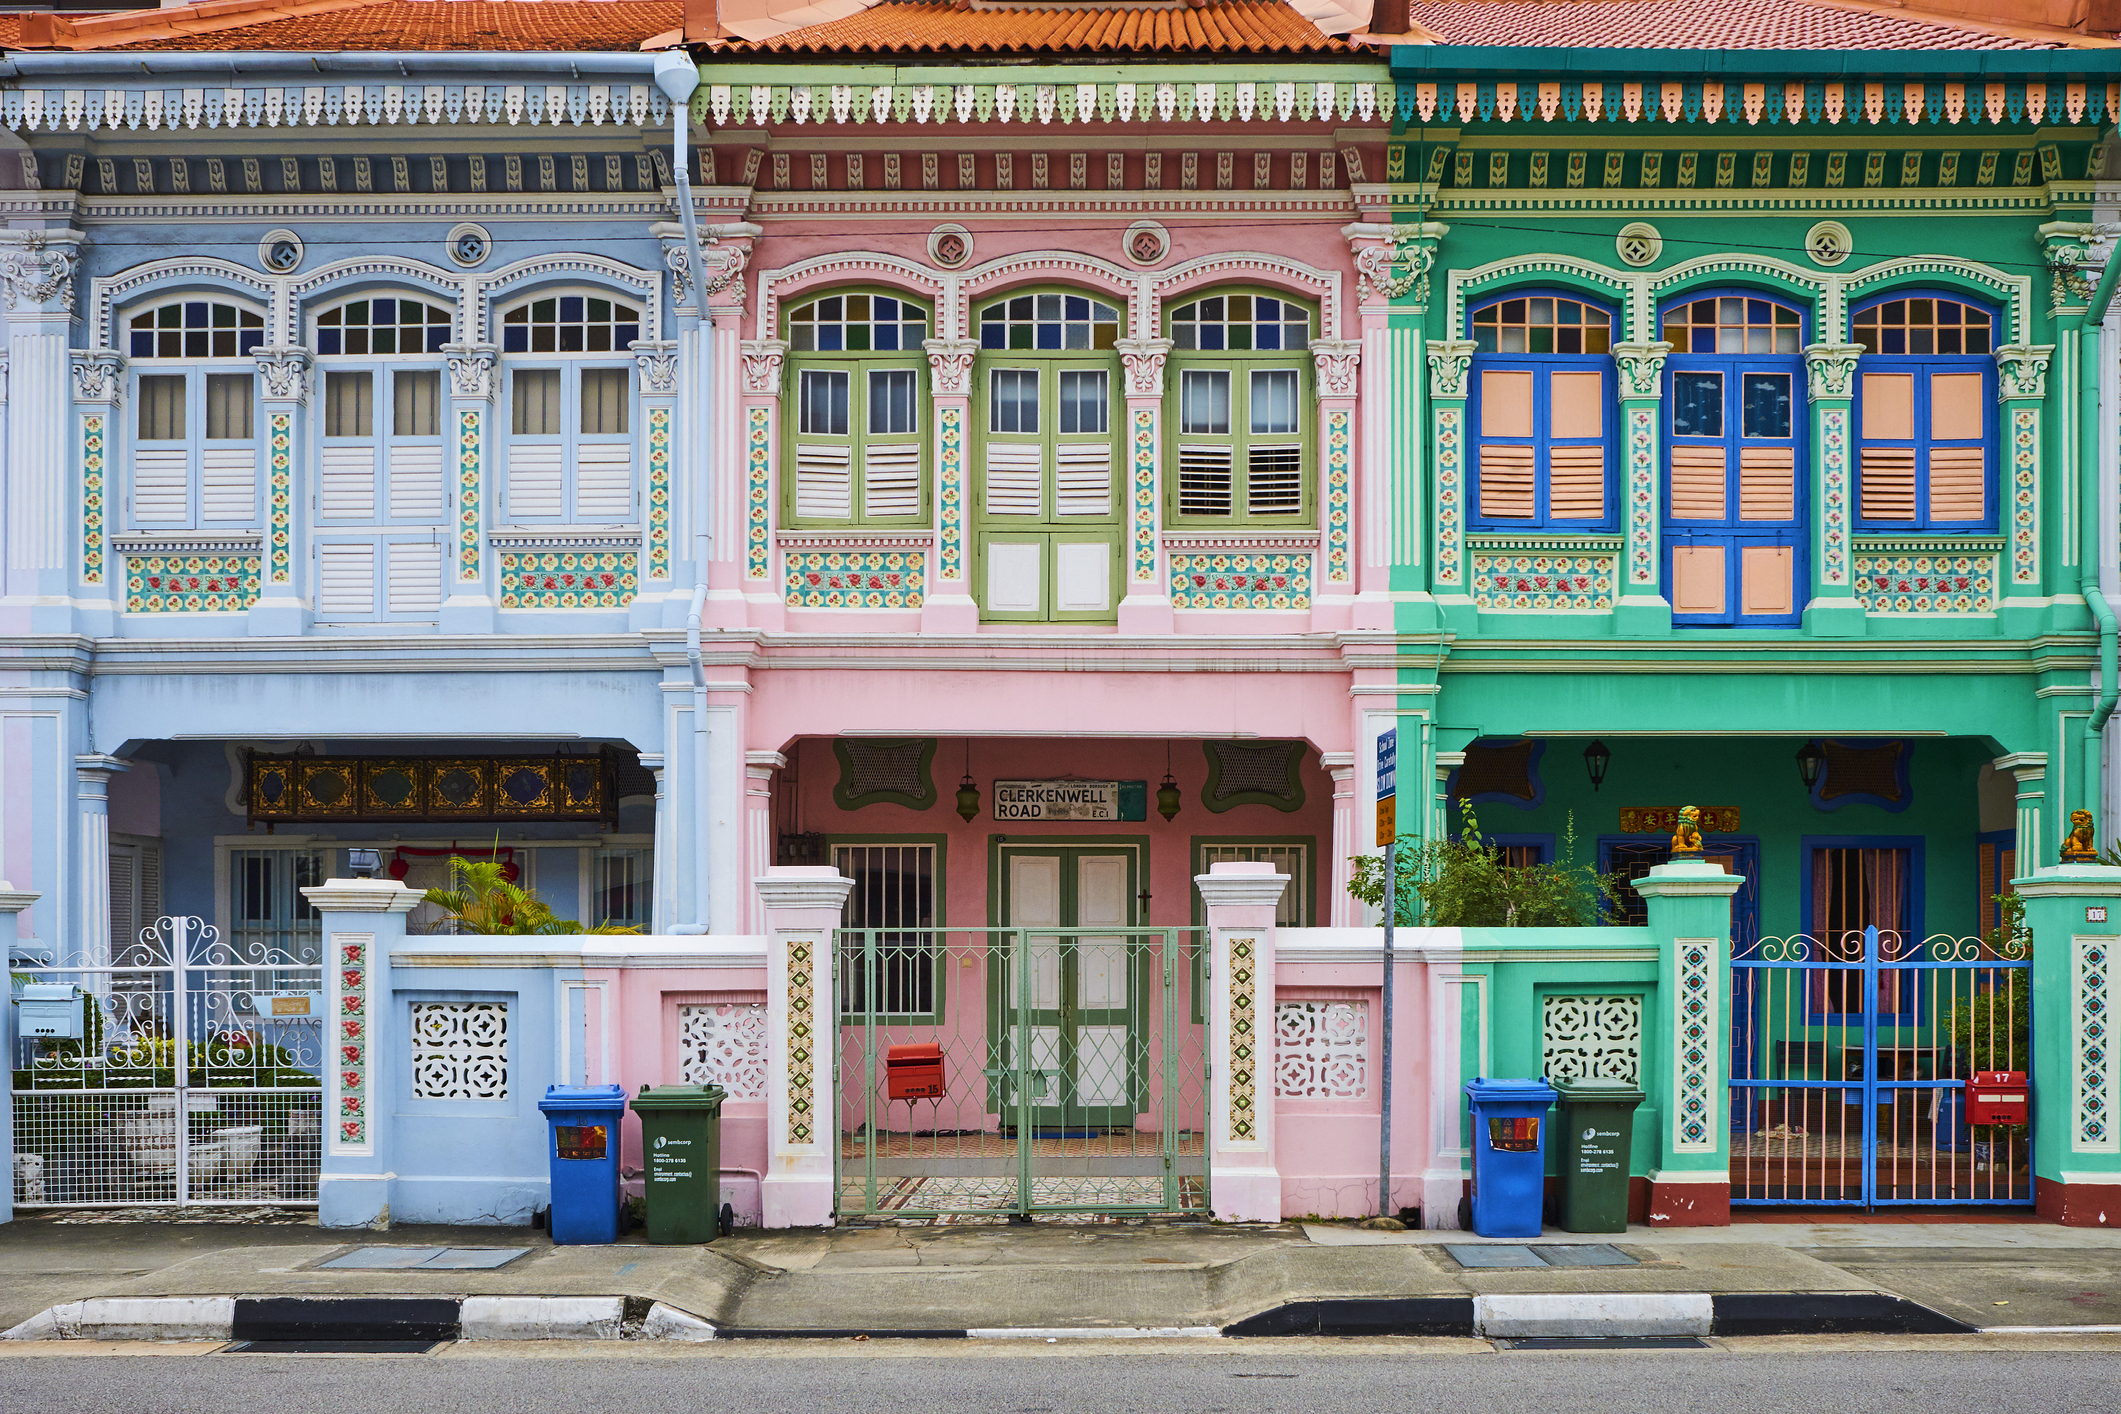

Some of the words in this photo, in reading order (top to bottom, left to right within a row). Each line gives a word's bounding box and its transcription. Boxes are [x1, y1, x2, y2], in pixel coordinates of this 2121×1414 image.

[999, 789, 1107, 803] CLERKENWELL
[998, 804, 1041, 817] ROAD
[2092, 911, 2102, 919] 17
[1995, 1073, 2009, 1083] 17
[928, 1084, 939, 1094] 15
[576, 1116, 588, 1126] 15
